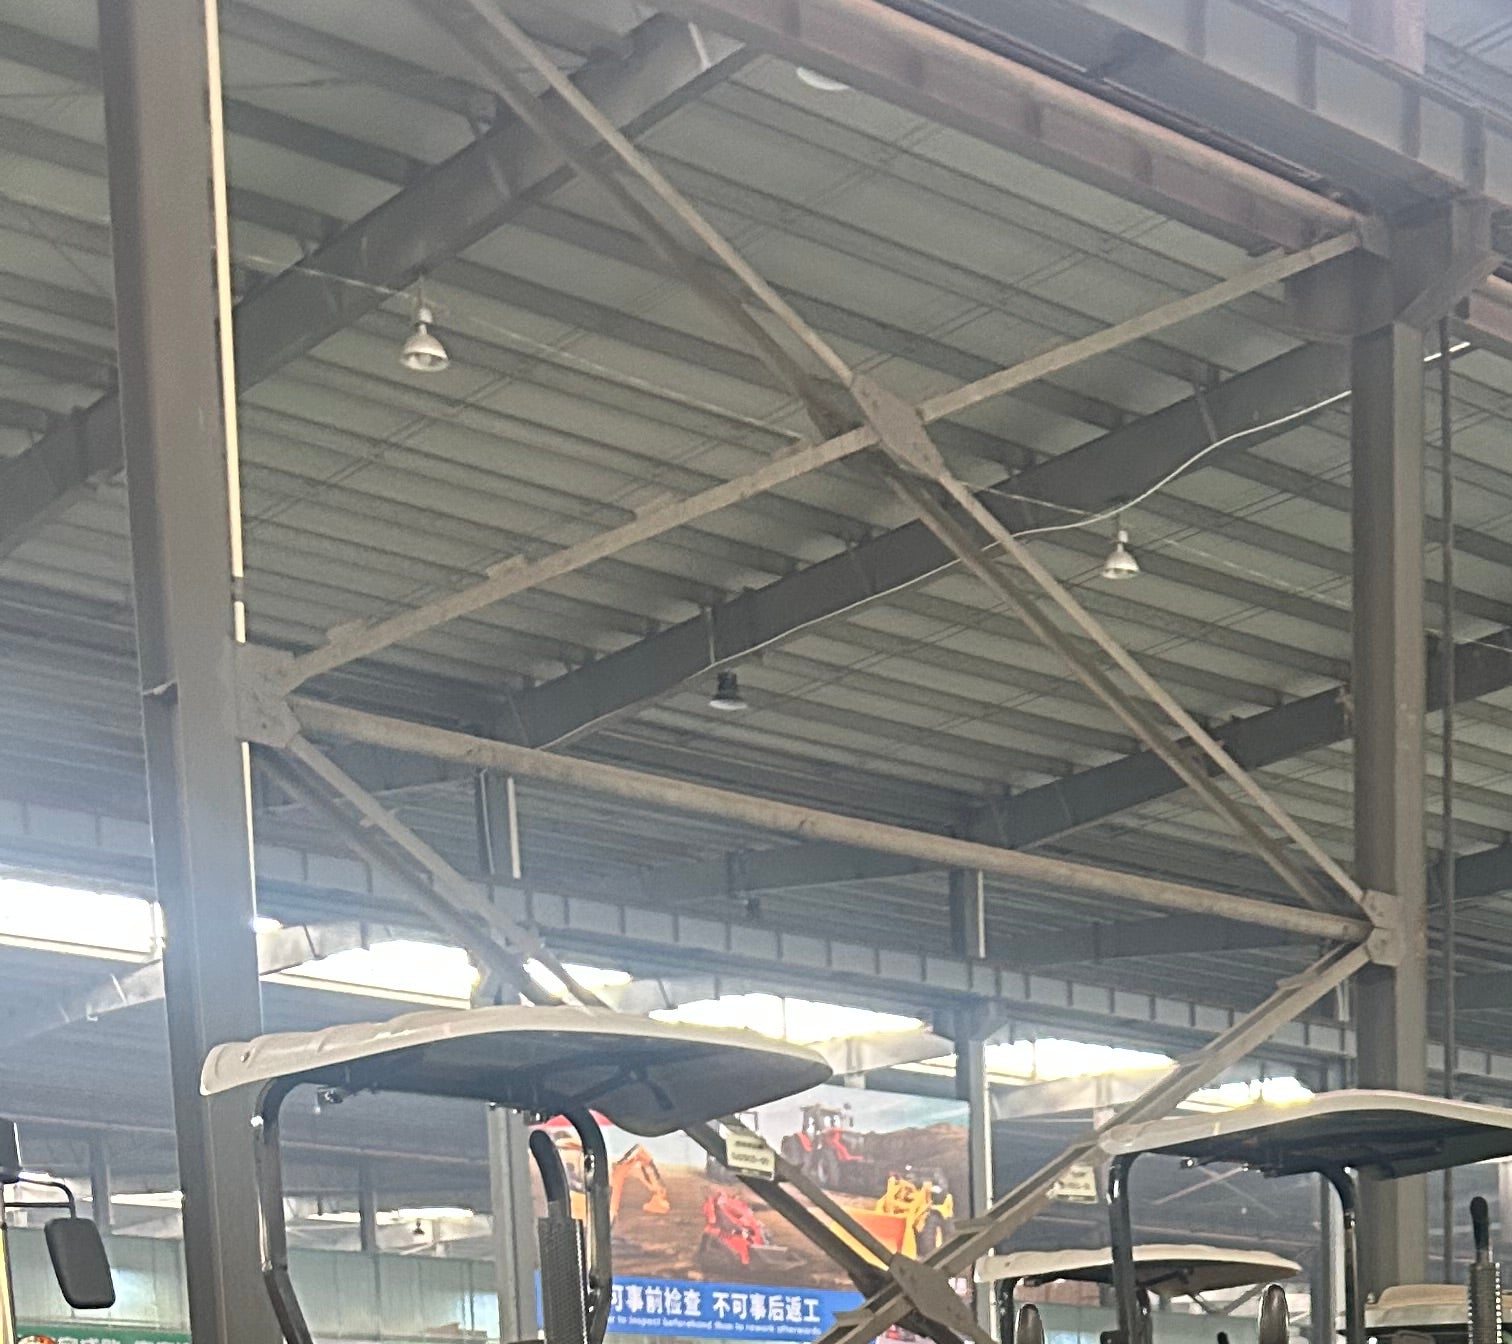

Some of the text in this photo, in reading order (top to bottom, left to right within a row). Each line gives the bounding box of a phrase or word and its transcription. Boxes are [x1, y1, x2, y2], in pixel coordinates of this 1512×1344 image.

[712, 1291, 820, 1323] 不可事后返工
[662, 1318, 713, 1329] beforehand
